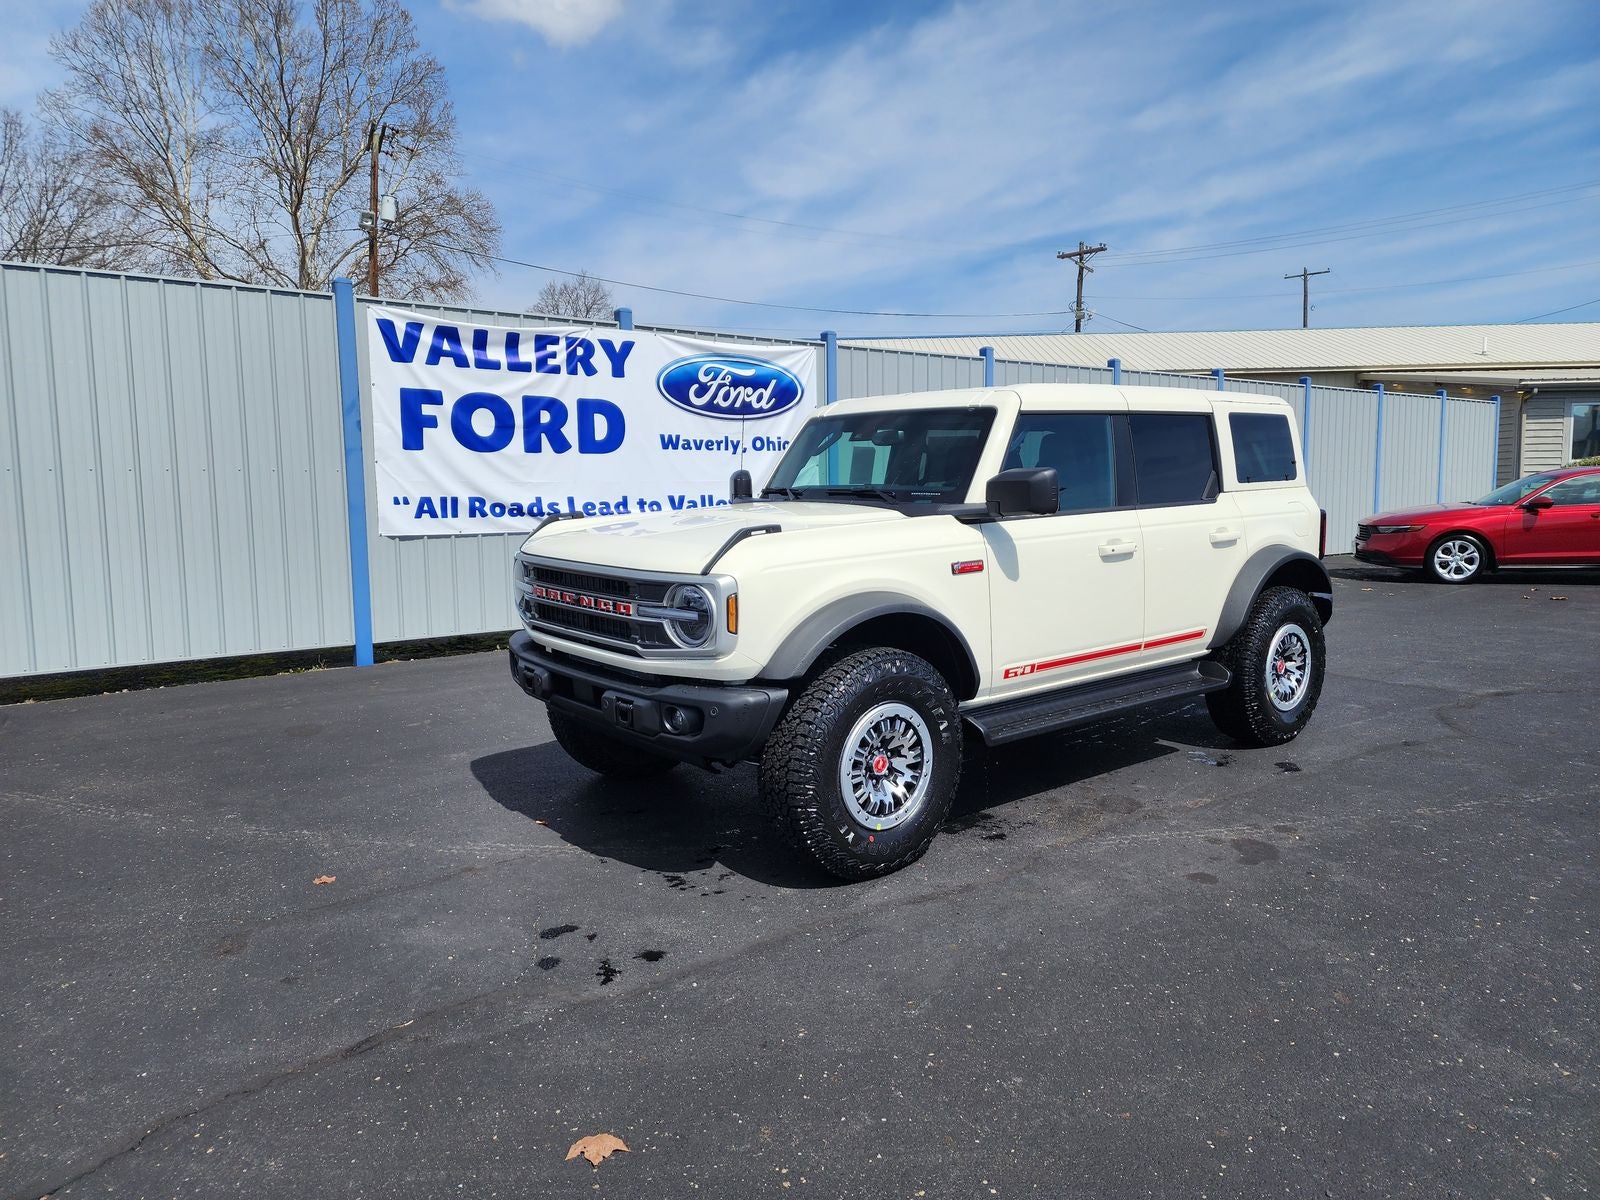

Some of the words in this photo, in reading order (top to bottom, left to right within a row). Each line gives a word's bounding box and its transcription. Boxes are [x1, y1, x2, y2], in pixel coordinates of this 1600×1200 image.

[375, 318, 635, 378] VALLERY
[688, 363, 777, 410] Ford
[400, 388, 626, 454] FORD
[660, 434, 747, 455] Waverly,
[393, 496, 459, 519] “All
[468, 496, 561, 518] Roads
[637, 498, 662, 512] to
[667, 494, 733, 511] Vall
[532, 585, 633, 616] BRONCO
